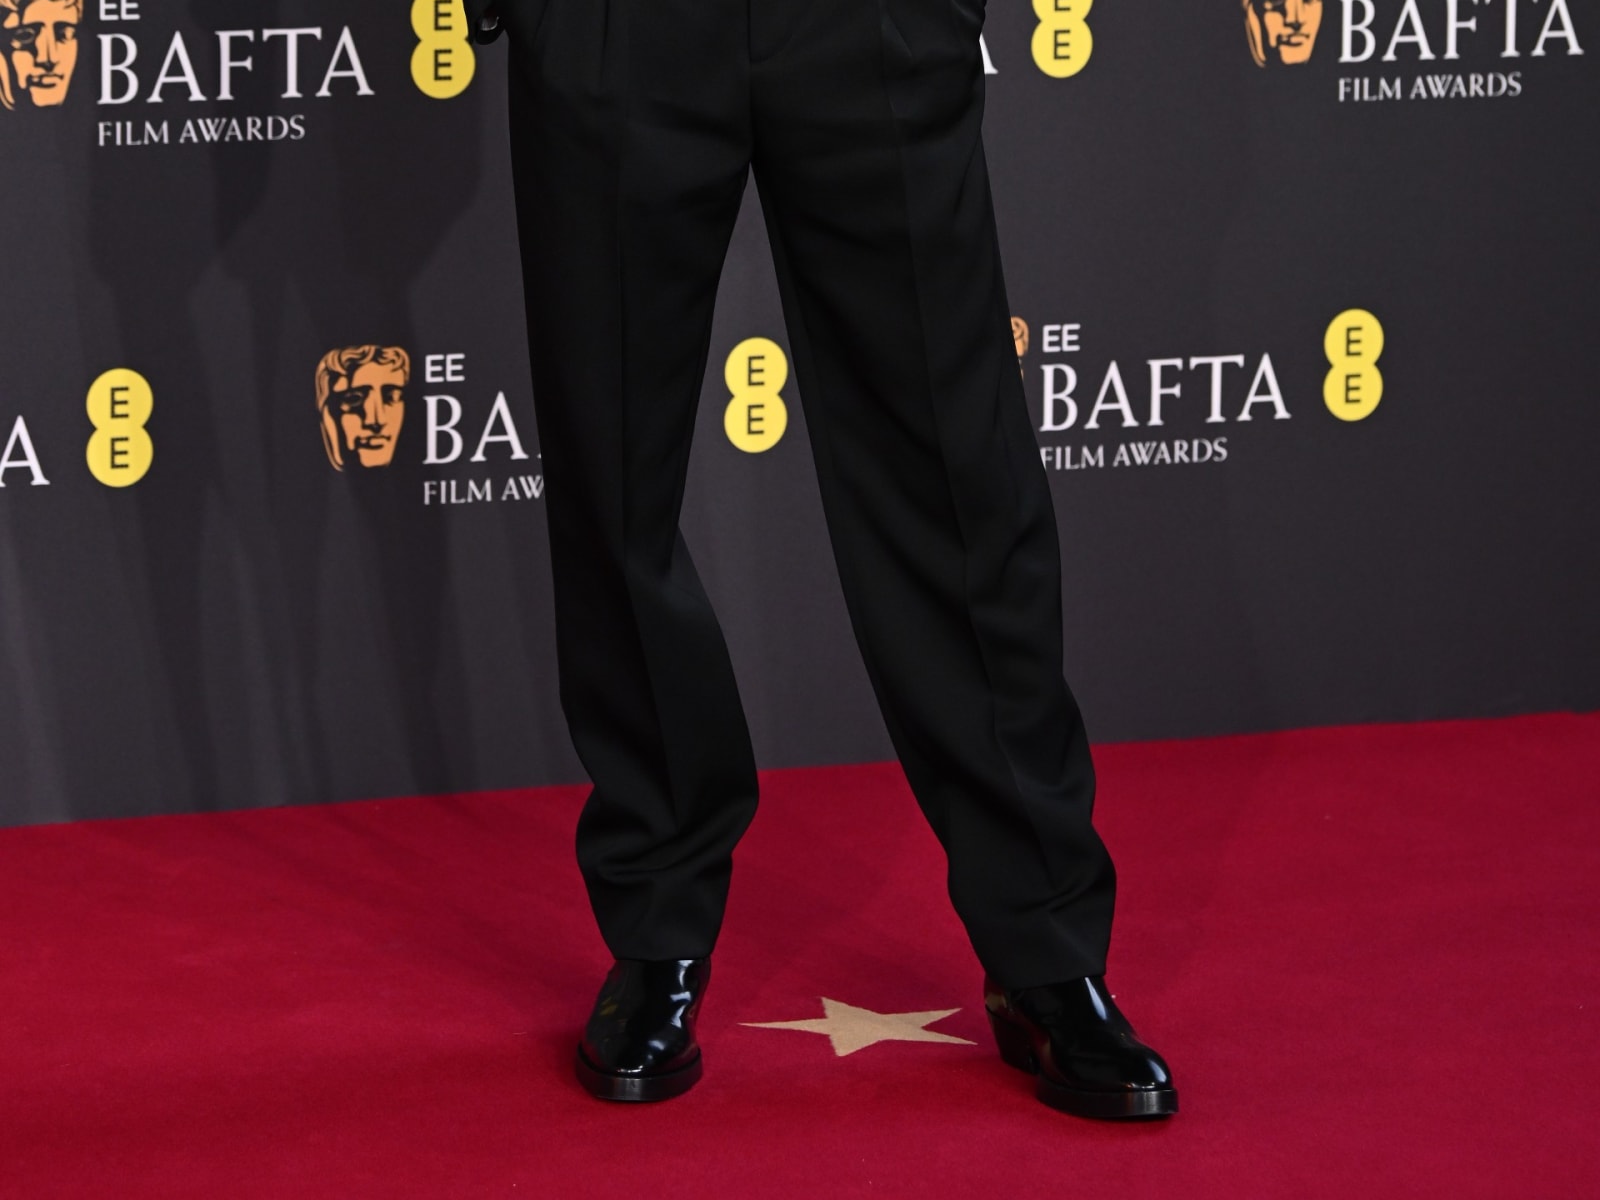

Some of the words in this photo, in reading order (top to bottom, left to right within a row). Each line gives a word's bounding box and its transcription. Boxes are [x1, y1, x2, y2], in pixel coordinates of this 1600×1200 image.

[98, 26, 374, 104] BAFTA
[1339, 78, 1401, 101] FILM
[1411, 73, 1521, 99] AWARDS
[99, 121, 168, 146] FILM
[180, 115, 304, 143] AWARDS
[1043, 324, 1080, 352] EE
[426, 354, 465, 382] EE
[1040, 353, 1291, 431] BAFTA
[424, 392, 541, 464] BA
[1040, 446, 1104, 470] FILM
[1114, 438, 1227, 466] AWARDS
[424, 479, 491, 504] FILM
